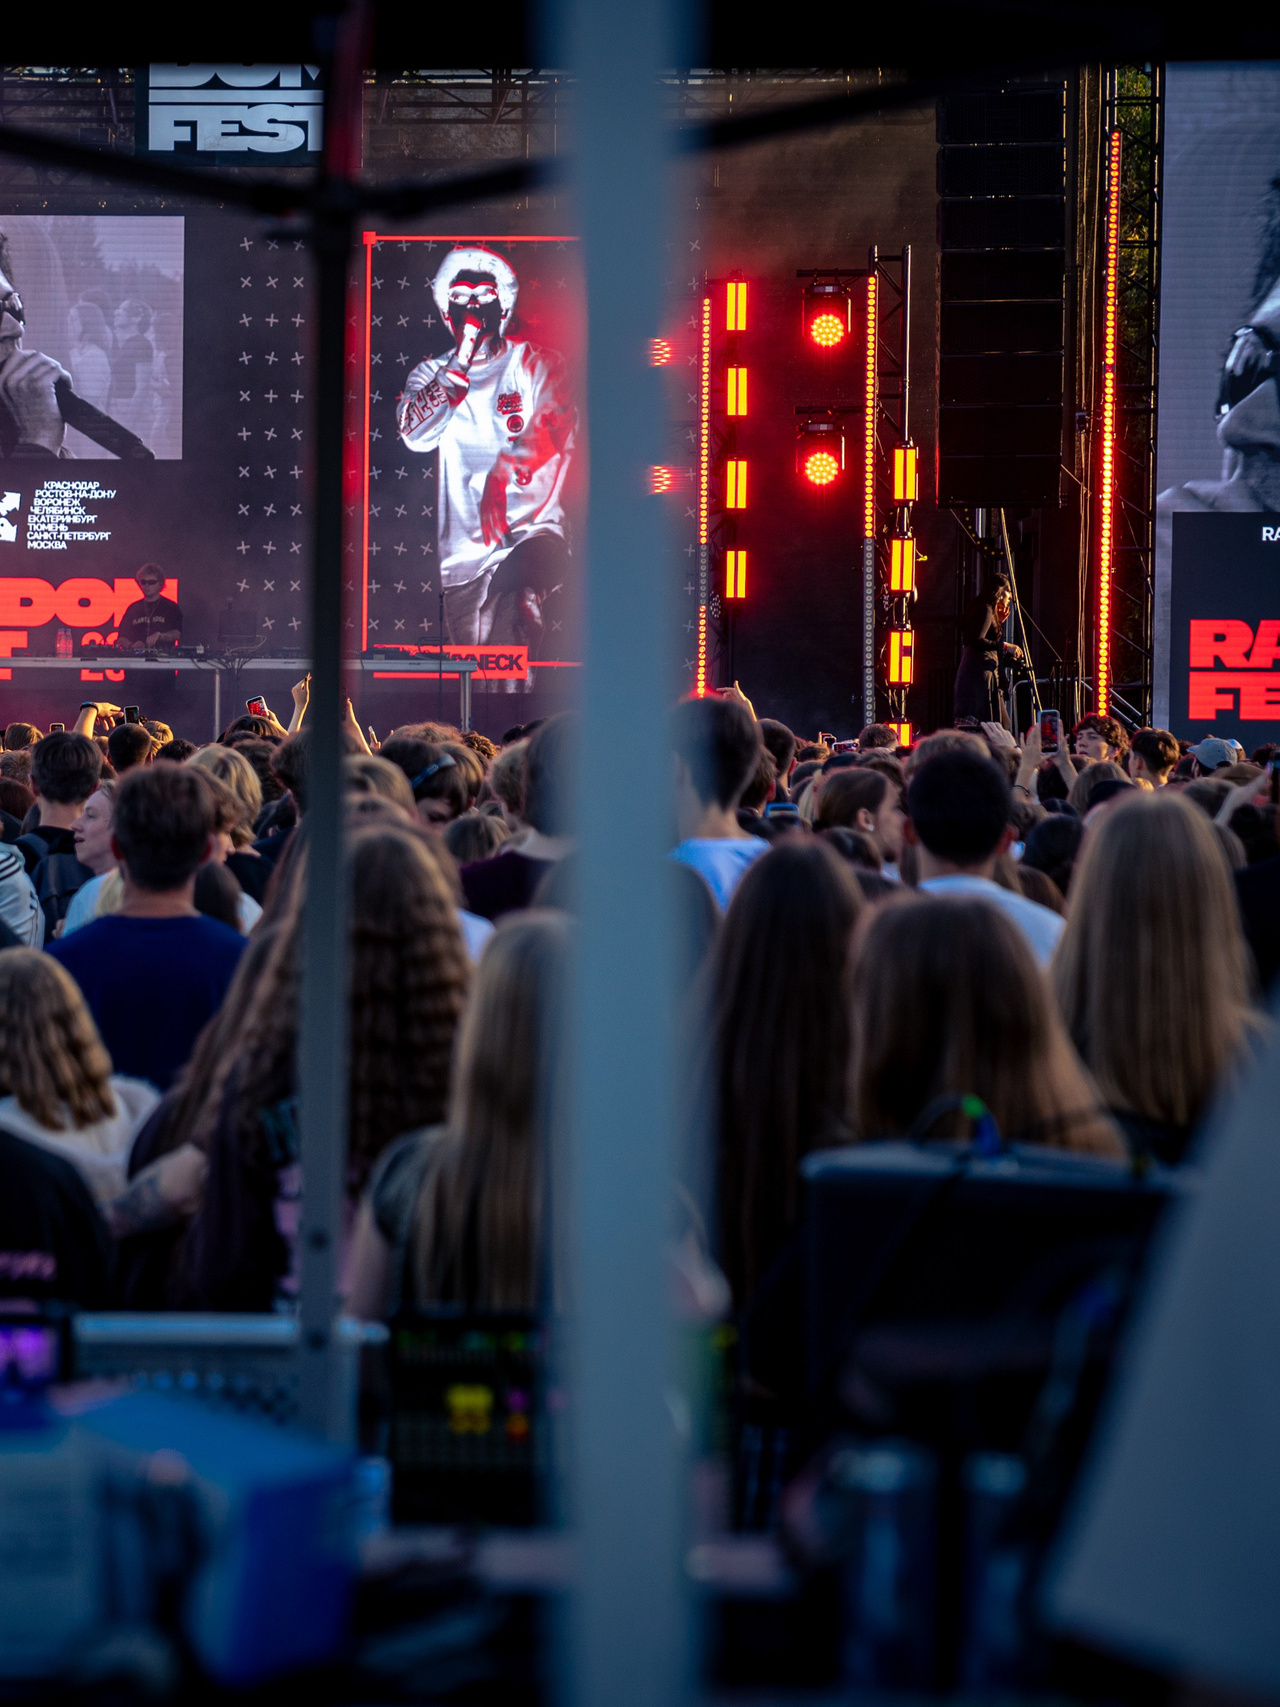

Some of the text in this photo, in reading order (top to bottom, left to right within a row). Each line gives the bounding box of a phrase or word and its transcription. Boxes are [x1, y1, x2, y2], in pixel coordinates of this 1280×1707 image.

[44, 481, 100, 490] КРАСНОДАР
[35, 489, 117, 499] РОСТОВ-НА-ДОНУ
[33, 498, 81, 506] ВОРОНЕЖ
[30, 506, 86, 515] ЧЕЛЯБИНСК
[27, 514, 98, 523] ЕКАТЕРИНБУРГ
[27, 523, 69, 531] ТЮМЕНЬ
[26, 531, 111, 540] САНКТ-ПЕТЕРБУРГ
[27, 540, 67, 549] МОСКВА
